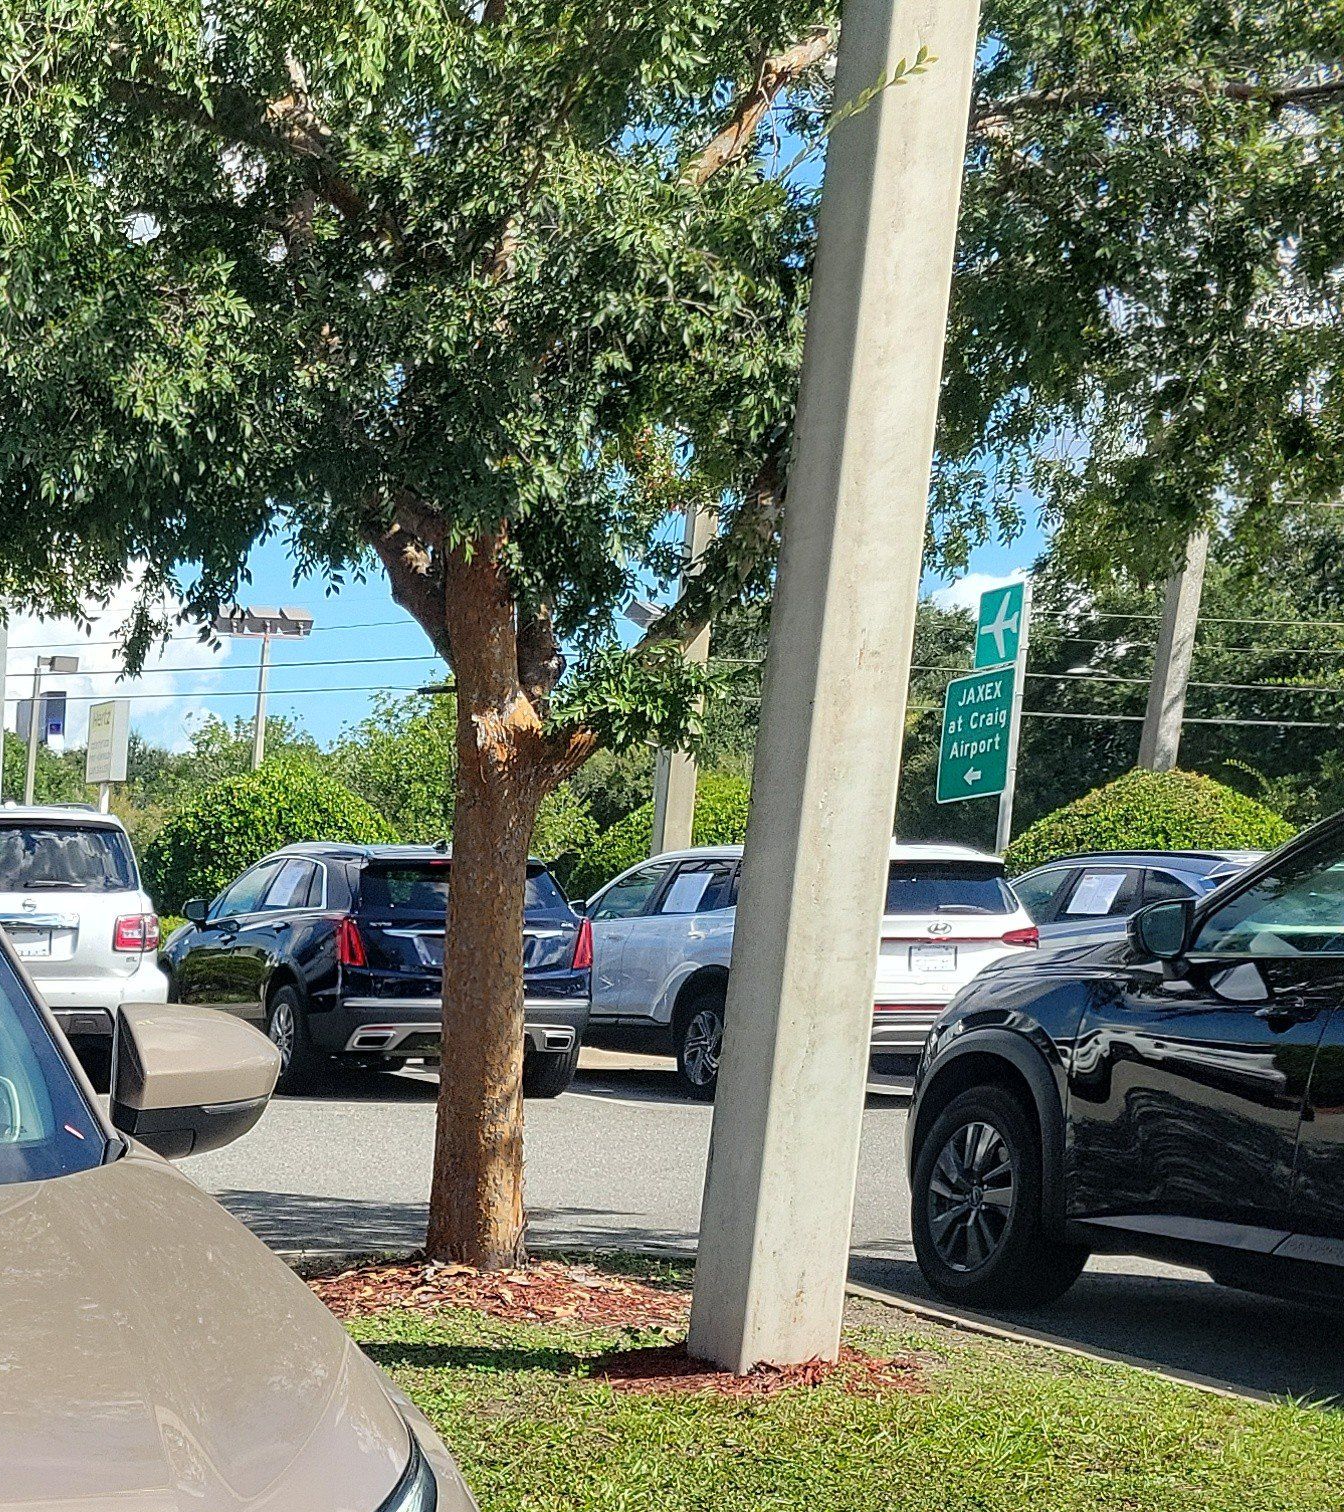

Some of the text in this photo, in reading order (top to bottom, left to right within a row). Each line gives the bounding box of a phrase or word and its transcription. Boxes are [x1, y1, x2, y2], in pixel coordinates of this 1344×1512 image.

[958, 681, 1002, 706] JAXEX
[948, 707, 1007, 734] at Craig
[949, 733, 1000, 759] Airport
